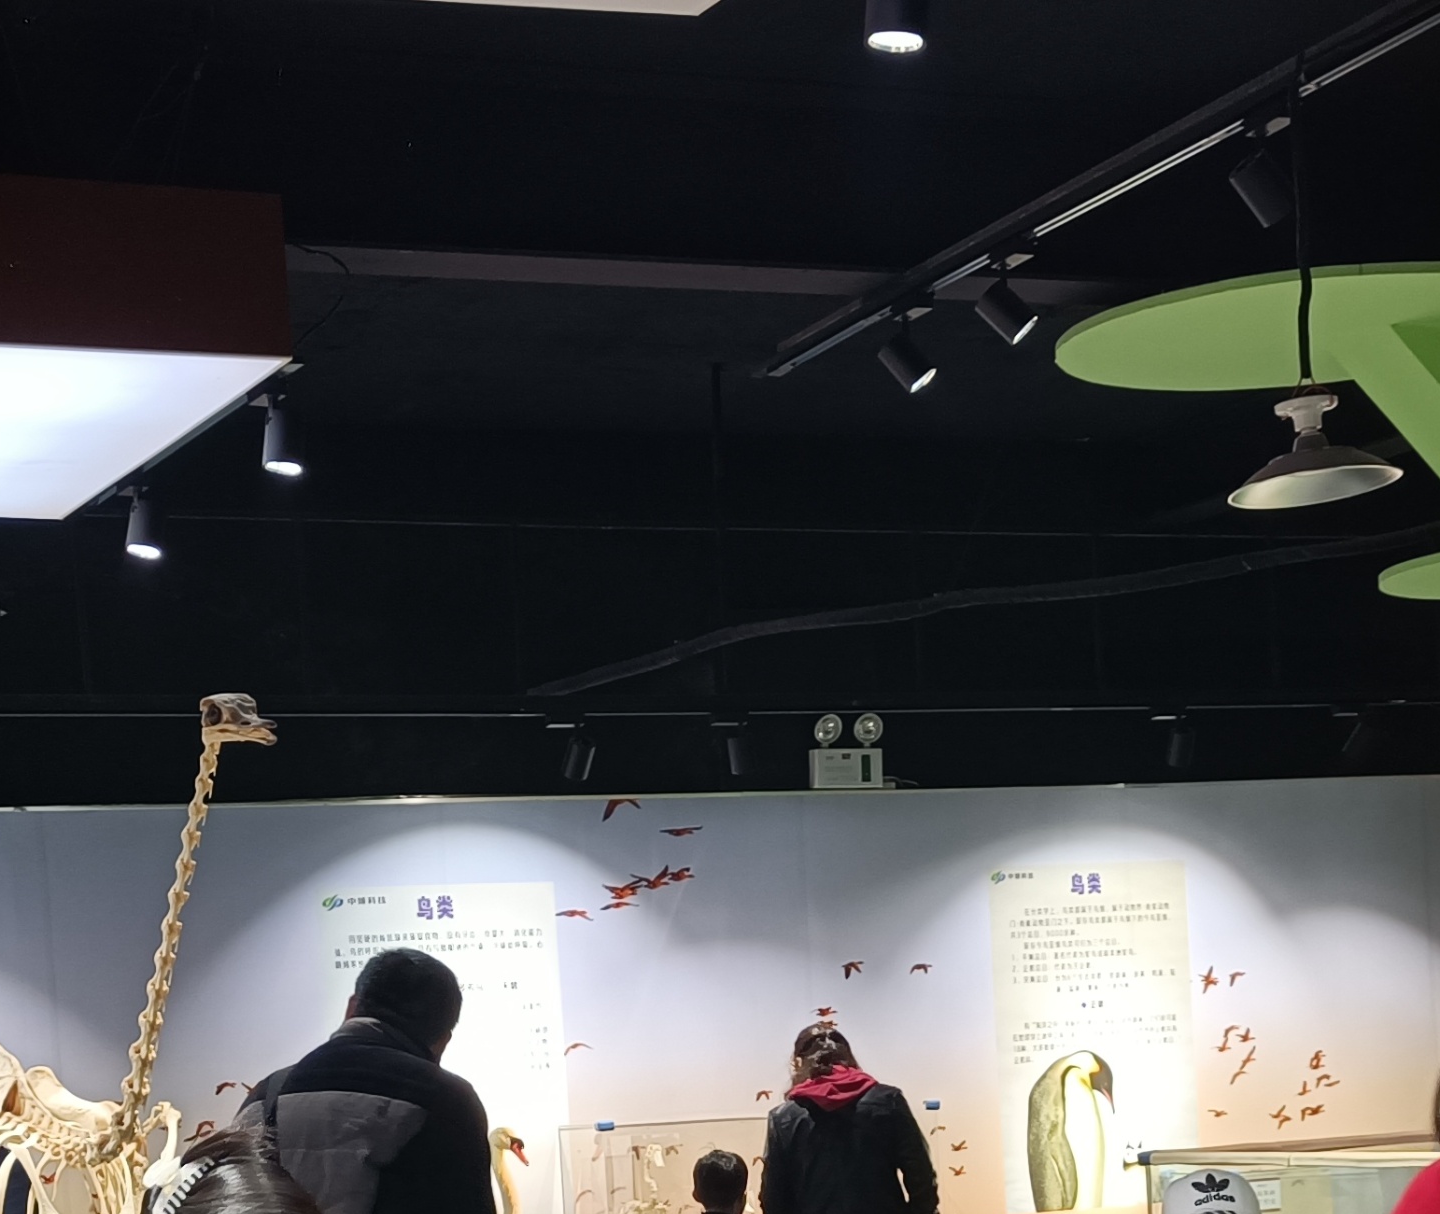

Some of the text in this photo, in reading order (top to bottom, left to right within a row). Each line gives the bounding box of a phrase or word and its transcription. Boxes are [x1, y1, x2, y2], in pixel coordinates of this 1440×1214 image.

[1071, 872, 1102, 895] 鸟类
[417, 896, 454, 920] 鸟类
[1194, 1193, 1236, 1206] adidas
